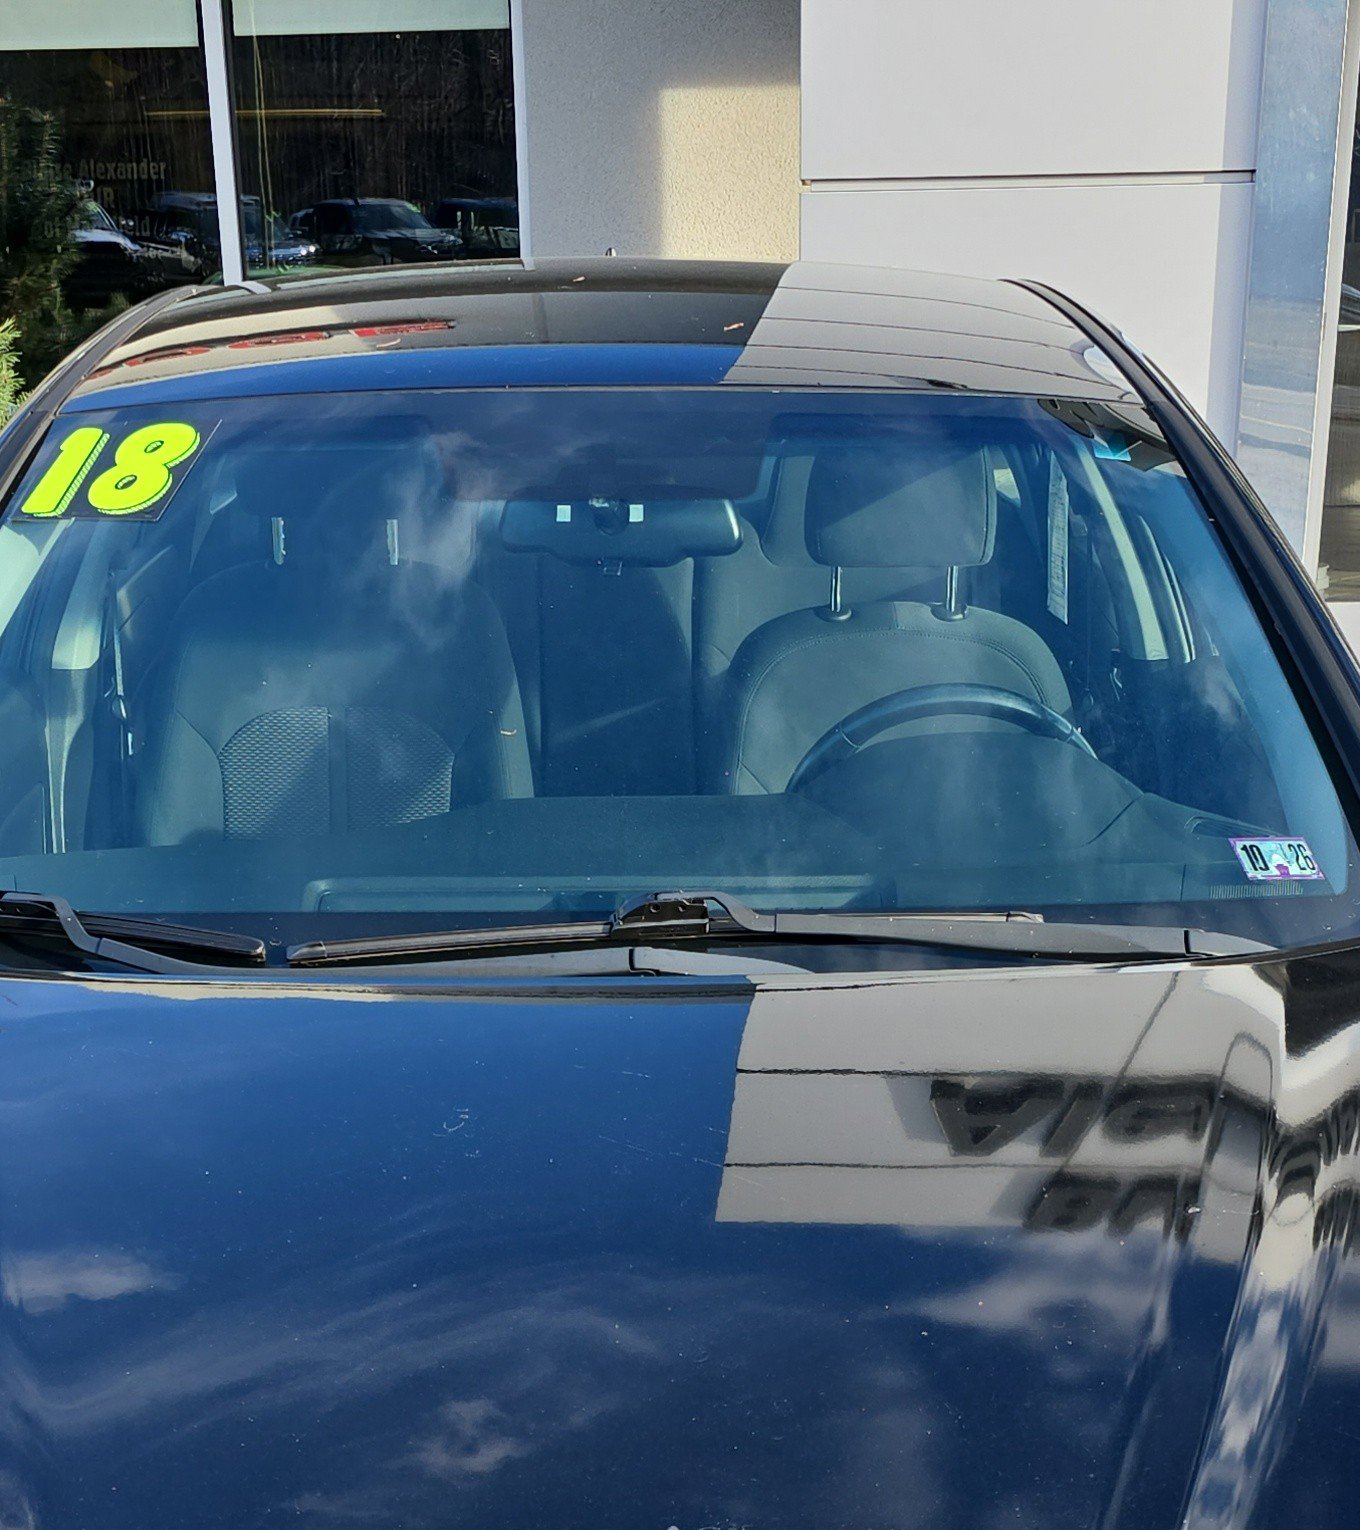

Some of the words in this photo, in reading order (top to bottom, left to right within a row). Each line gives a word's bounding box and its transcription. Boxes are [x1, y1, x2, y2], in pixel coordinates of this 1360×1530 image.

[78, 158, 167, 180] Alexander
[20, 422, 201, 517] 18
[1241, 844, 1270, 871] 10
